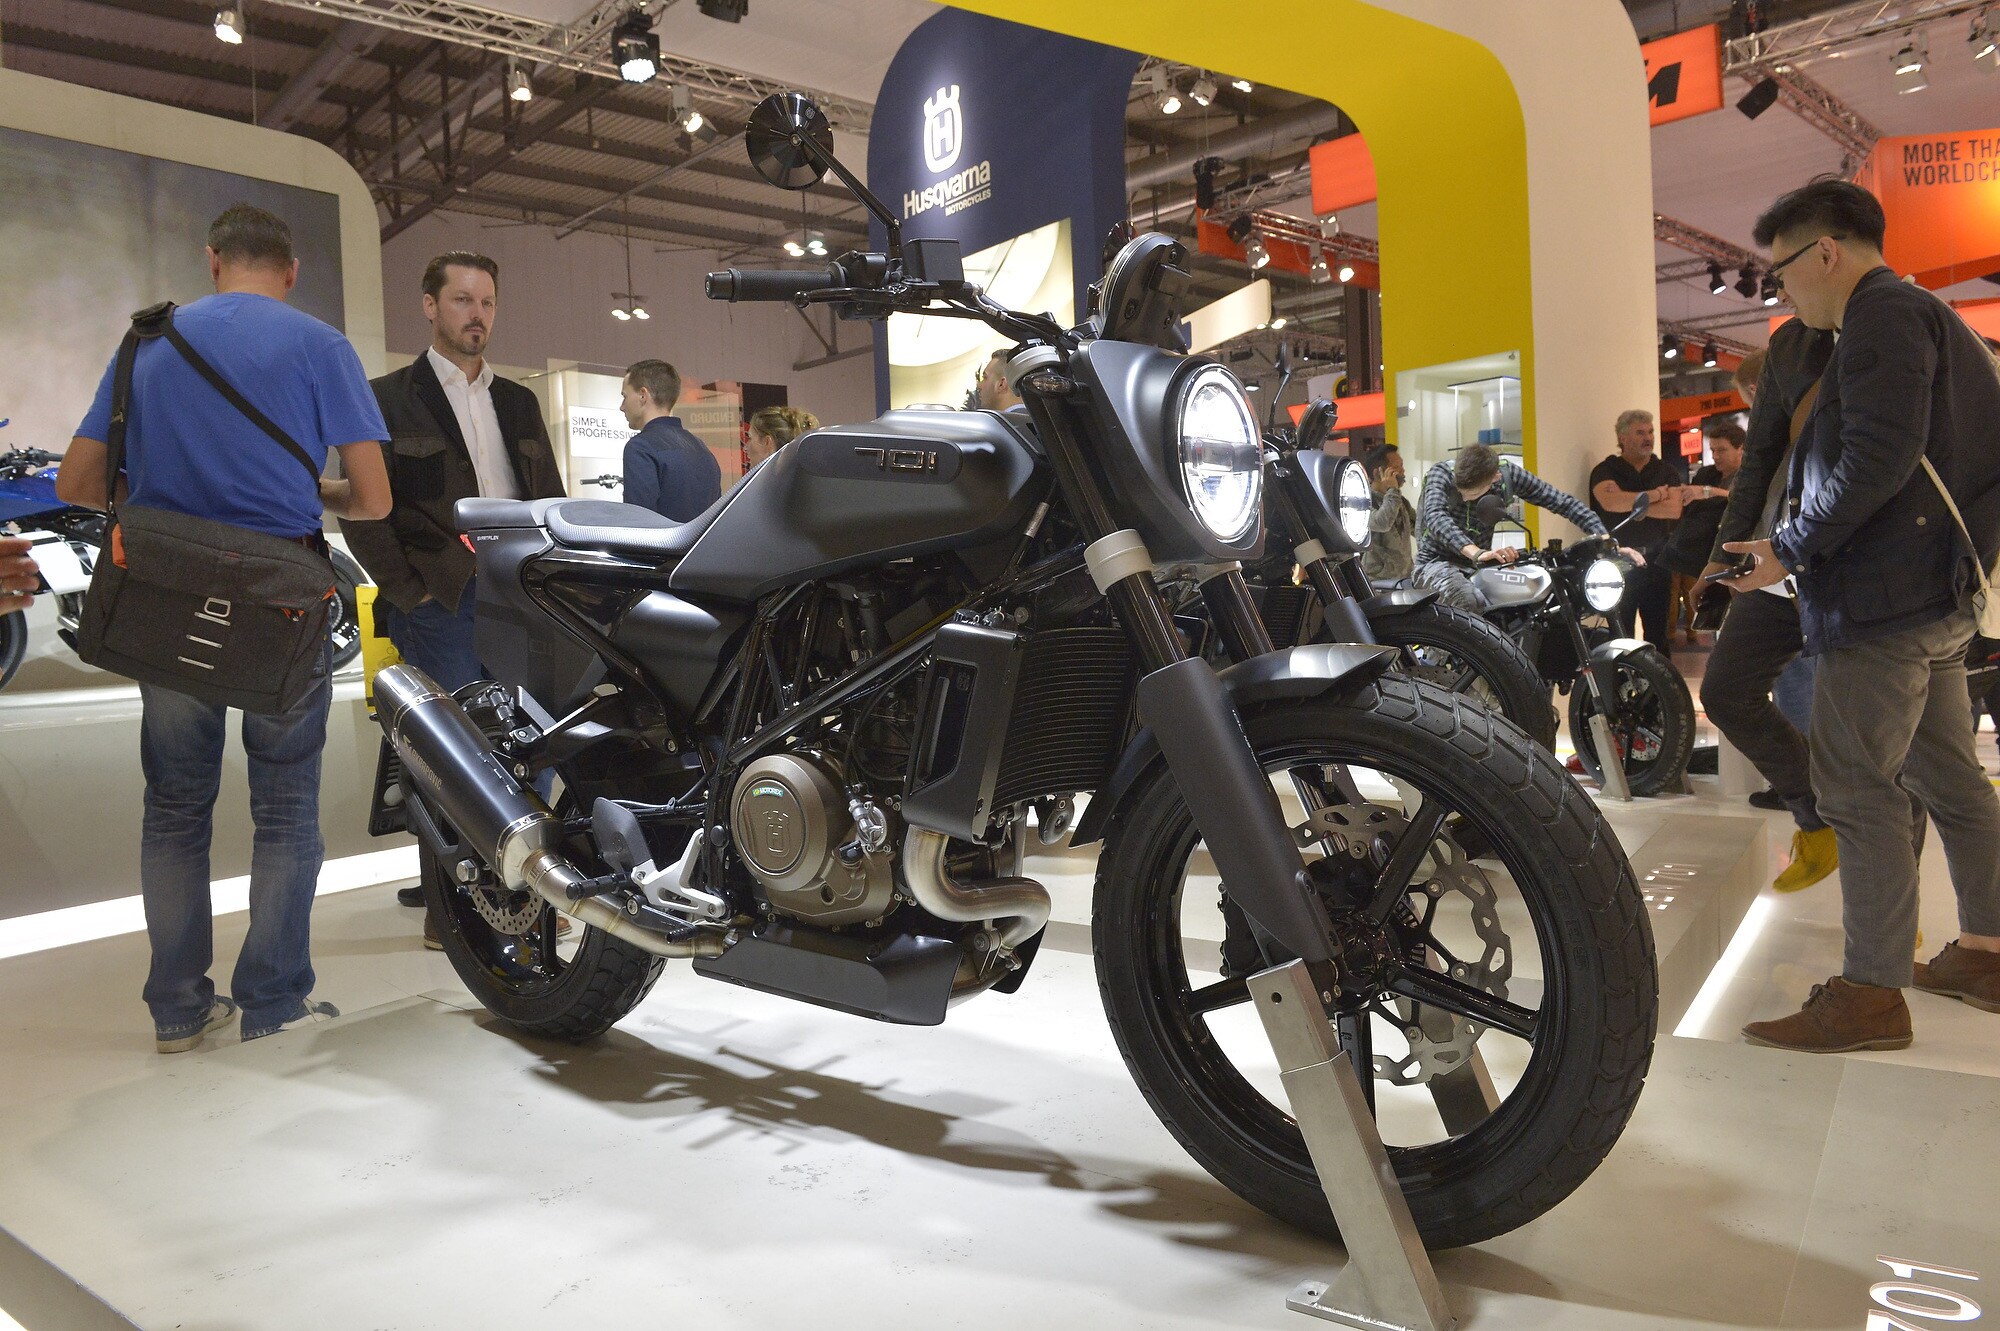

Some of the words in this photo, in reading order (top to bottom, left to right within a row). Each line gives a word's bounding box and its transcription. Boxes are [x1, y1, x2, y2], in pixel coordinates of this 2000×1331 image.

[1903, 141, 1961, 164] MORE
[903, 160, 991, 219] Husqvarna
[945, 188, 992, 217] MOTORCYCLES
[854, 446, 938, 470] 701
[1494, 572, 1526, 584] 701
